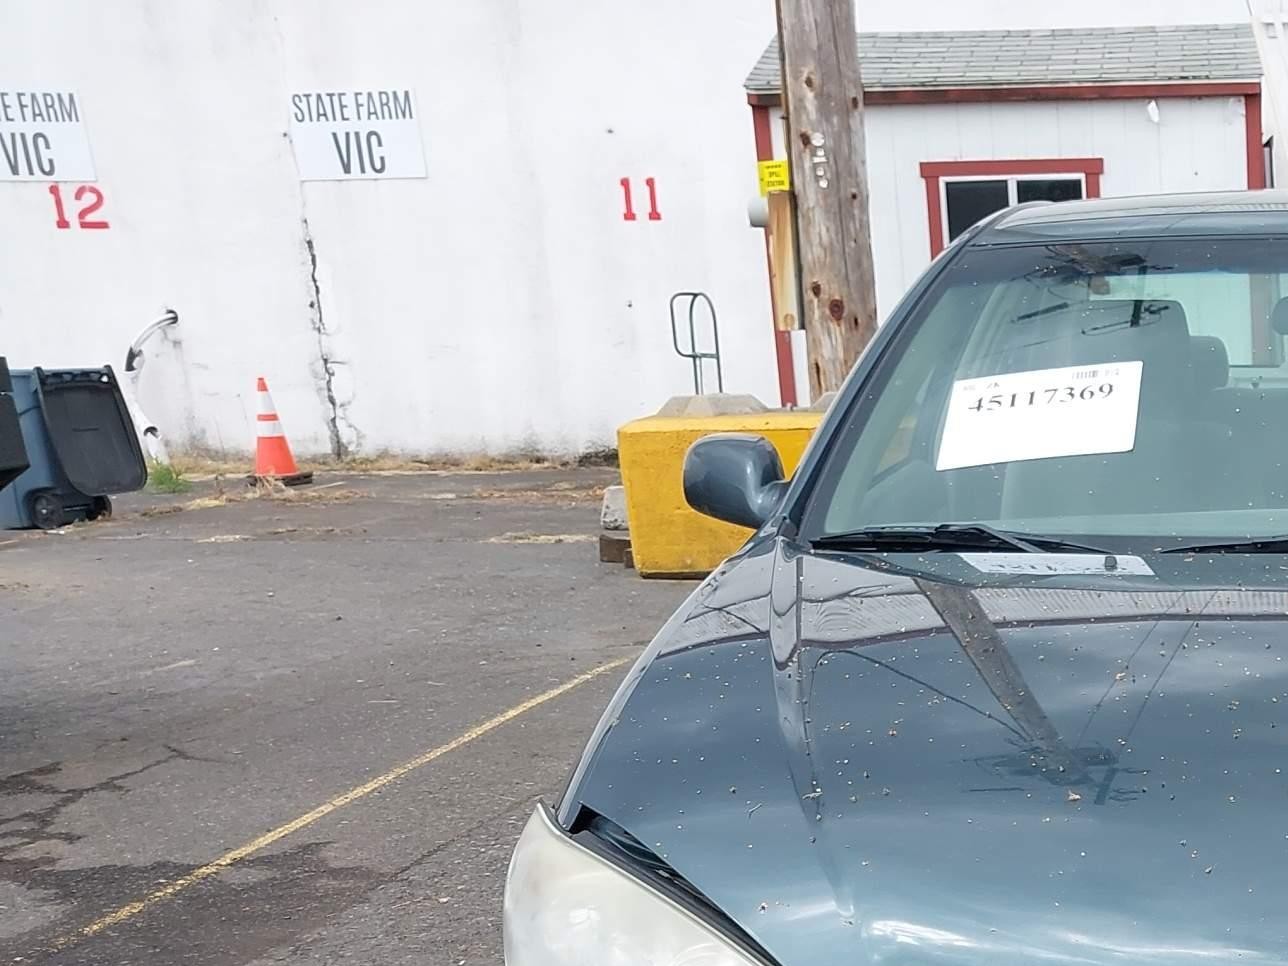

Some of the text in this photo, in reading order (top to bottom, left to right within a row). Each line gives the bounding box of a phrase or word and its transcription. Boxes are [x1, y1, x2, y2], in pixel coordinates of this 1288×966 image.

[16, 92, 80, 122] FARM
[292, 90, 414, 123] STATE FARM
[0, 131, 55, 176] VIC
[331, 130, 386, 174] VIC
[48, 184, 110, 229] 12
[620, 177, 662, 221] 11
[967, 382, 1114, 412] 45117369
